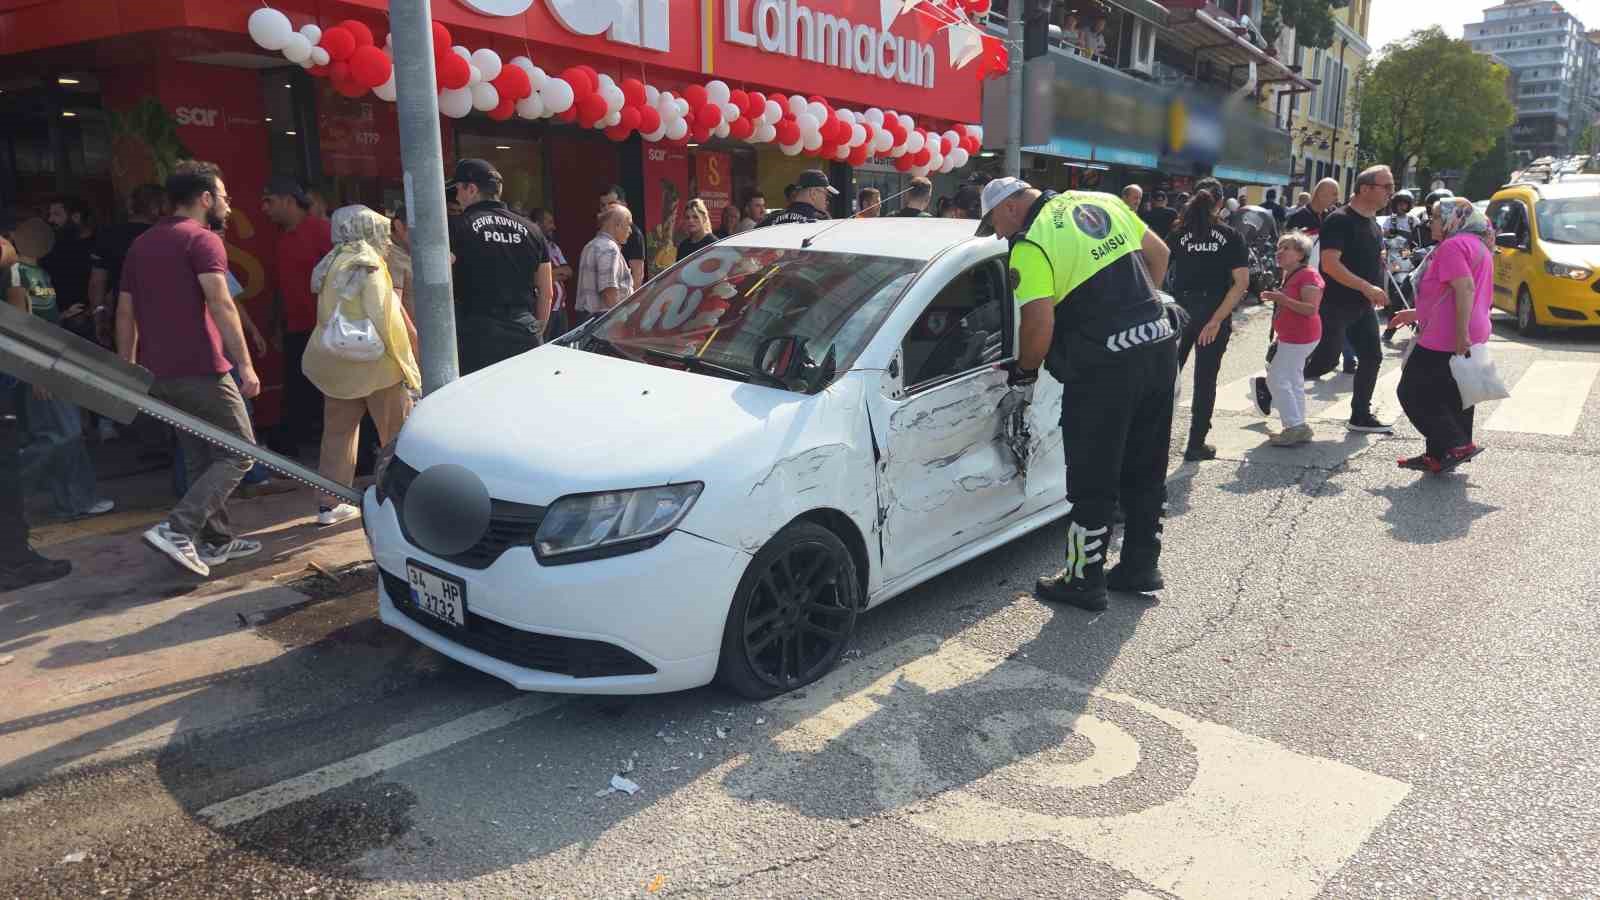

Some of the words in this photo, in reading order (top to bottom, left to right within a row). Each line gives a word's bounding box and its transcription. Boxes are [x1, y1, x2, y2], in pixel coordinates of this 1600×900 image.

[723, 0, 936, 89] Lahmacun
[175, 106, 218, 127] sar
[494, 215, 529, 237] KUVVET
[410, 568, 426, 590] 34
[441, 582, 459, 602] HP
[424, 592, 456, 622] 3732
